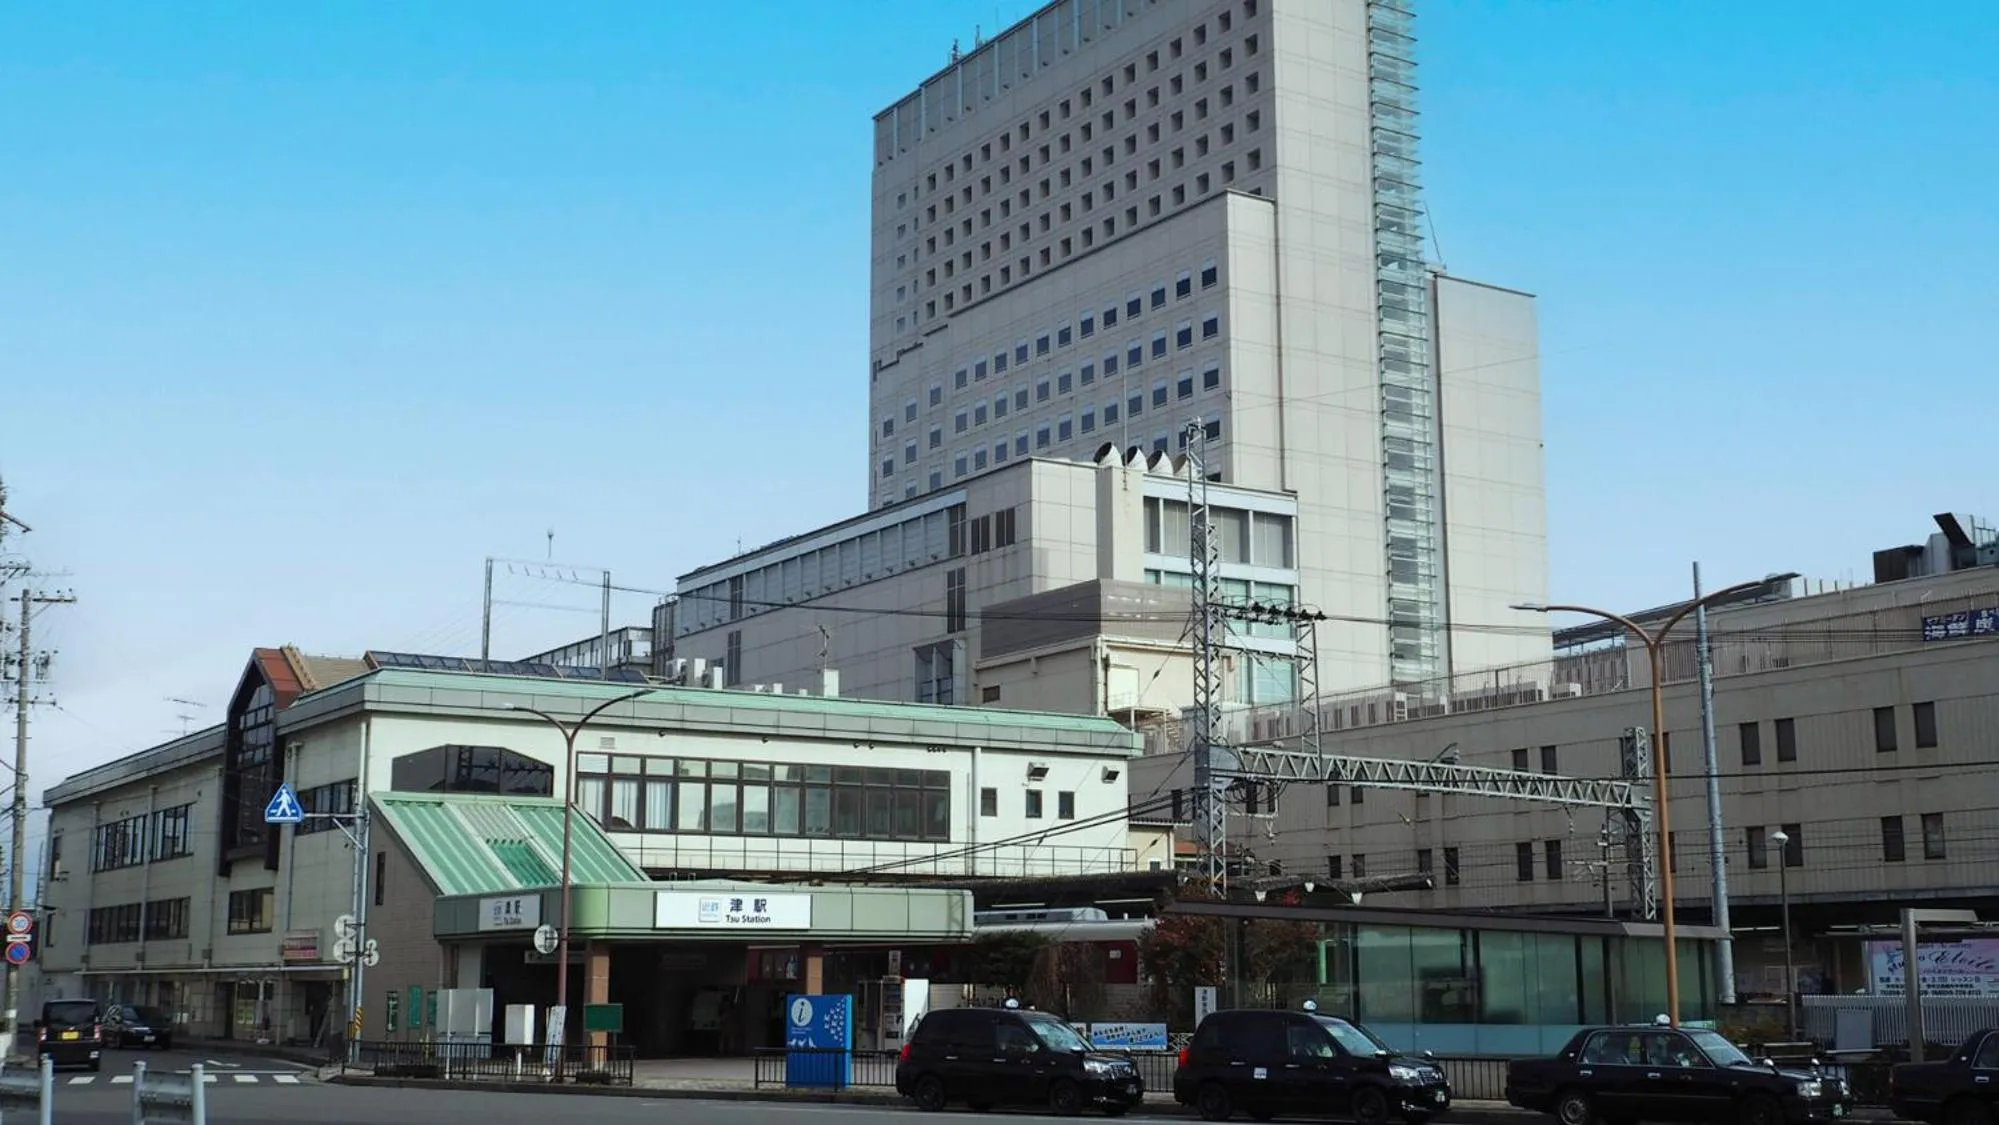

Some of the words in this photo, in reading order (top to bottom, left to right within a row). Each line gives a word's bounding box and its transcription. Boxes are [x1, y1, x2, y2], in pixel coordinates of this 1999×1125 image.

[729, 898, 767, 913] 津駅
[725, 914, 740, 924] Tsu
[741, 914, 771, 924] Station
